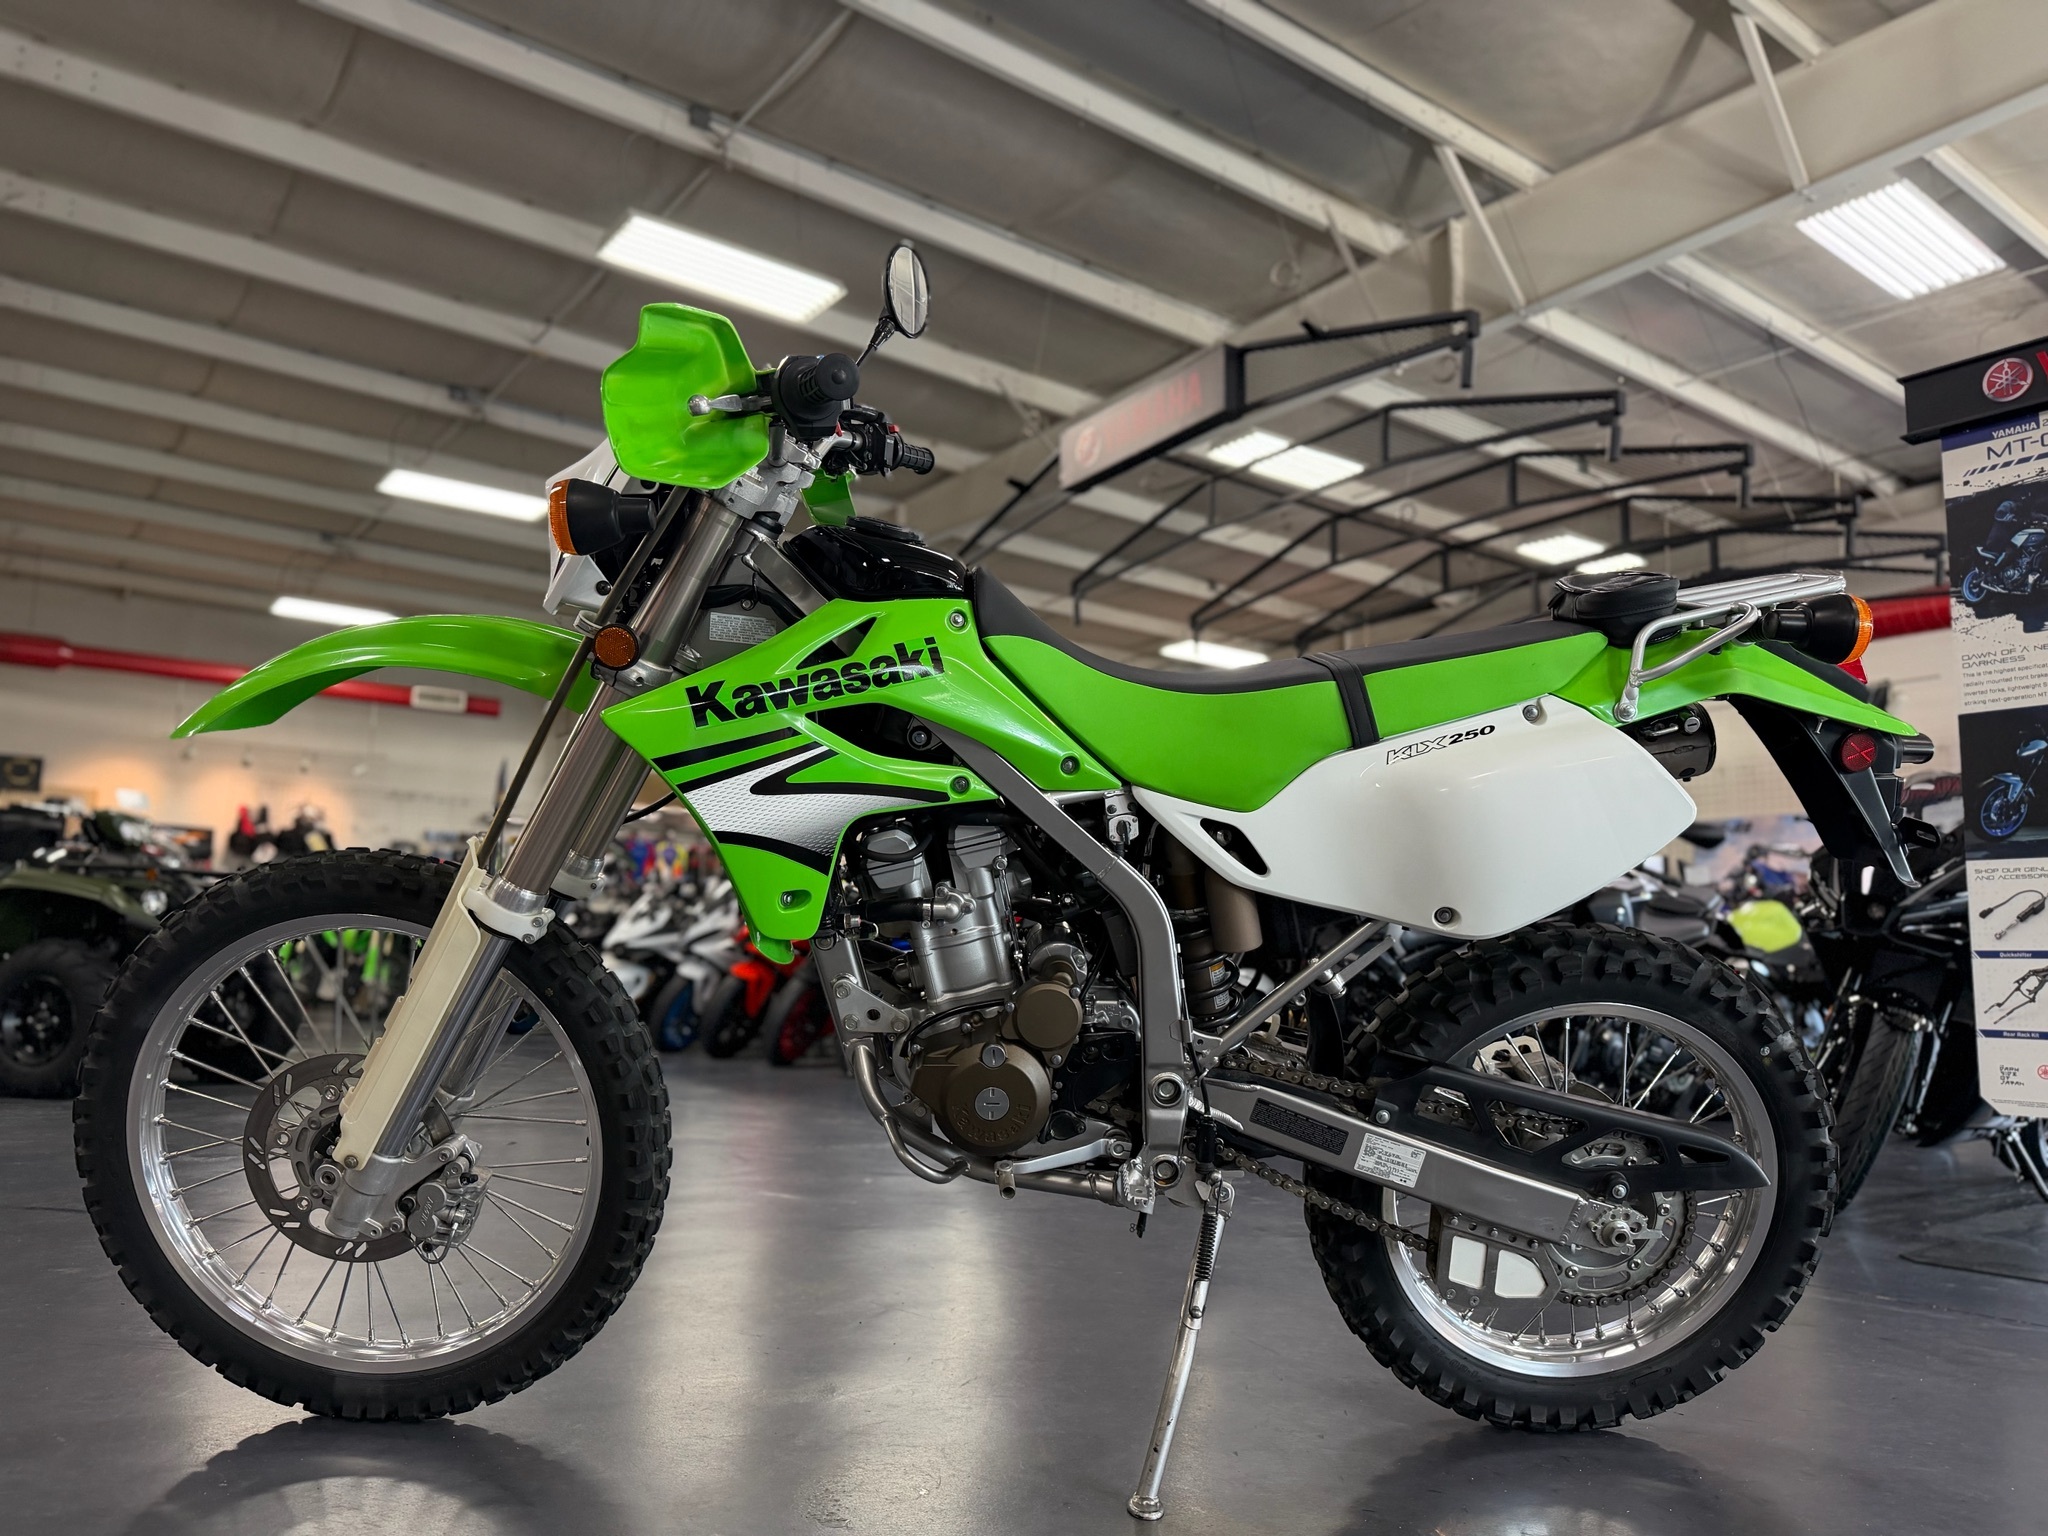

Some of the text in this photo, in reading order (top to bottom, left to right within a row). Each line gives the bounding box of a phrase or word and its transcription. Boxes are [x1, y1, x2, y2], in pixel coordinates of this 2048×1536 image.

[1992, 421, 2038, 439] YAMAHA
[1961, 651, 1997, 662] DAWN
[2000, 648, 2017, 656] OF
[1961, 655, 2026, 669] DARKNESS
[1994, 667, 2017, 675] highest
[685, 637, 945, 728] Kawasaki
[1986, 677, 2013, 685] mounted
[1964, 689, 1988, 697] inverted
[2008, 682, 2042, 692] lightweight
[1964, 697, 1987, 706] striking
[1988, 693, 2037, 703] next-generation
[952, 1103, 1032, 1143] Kawasaki
